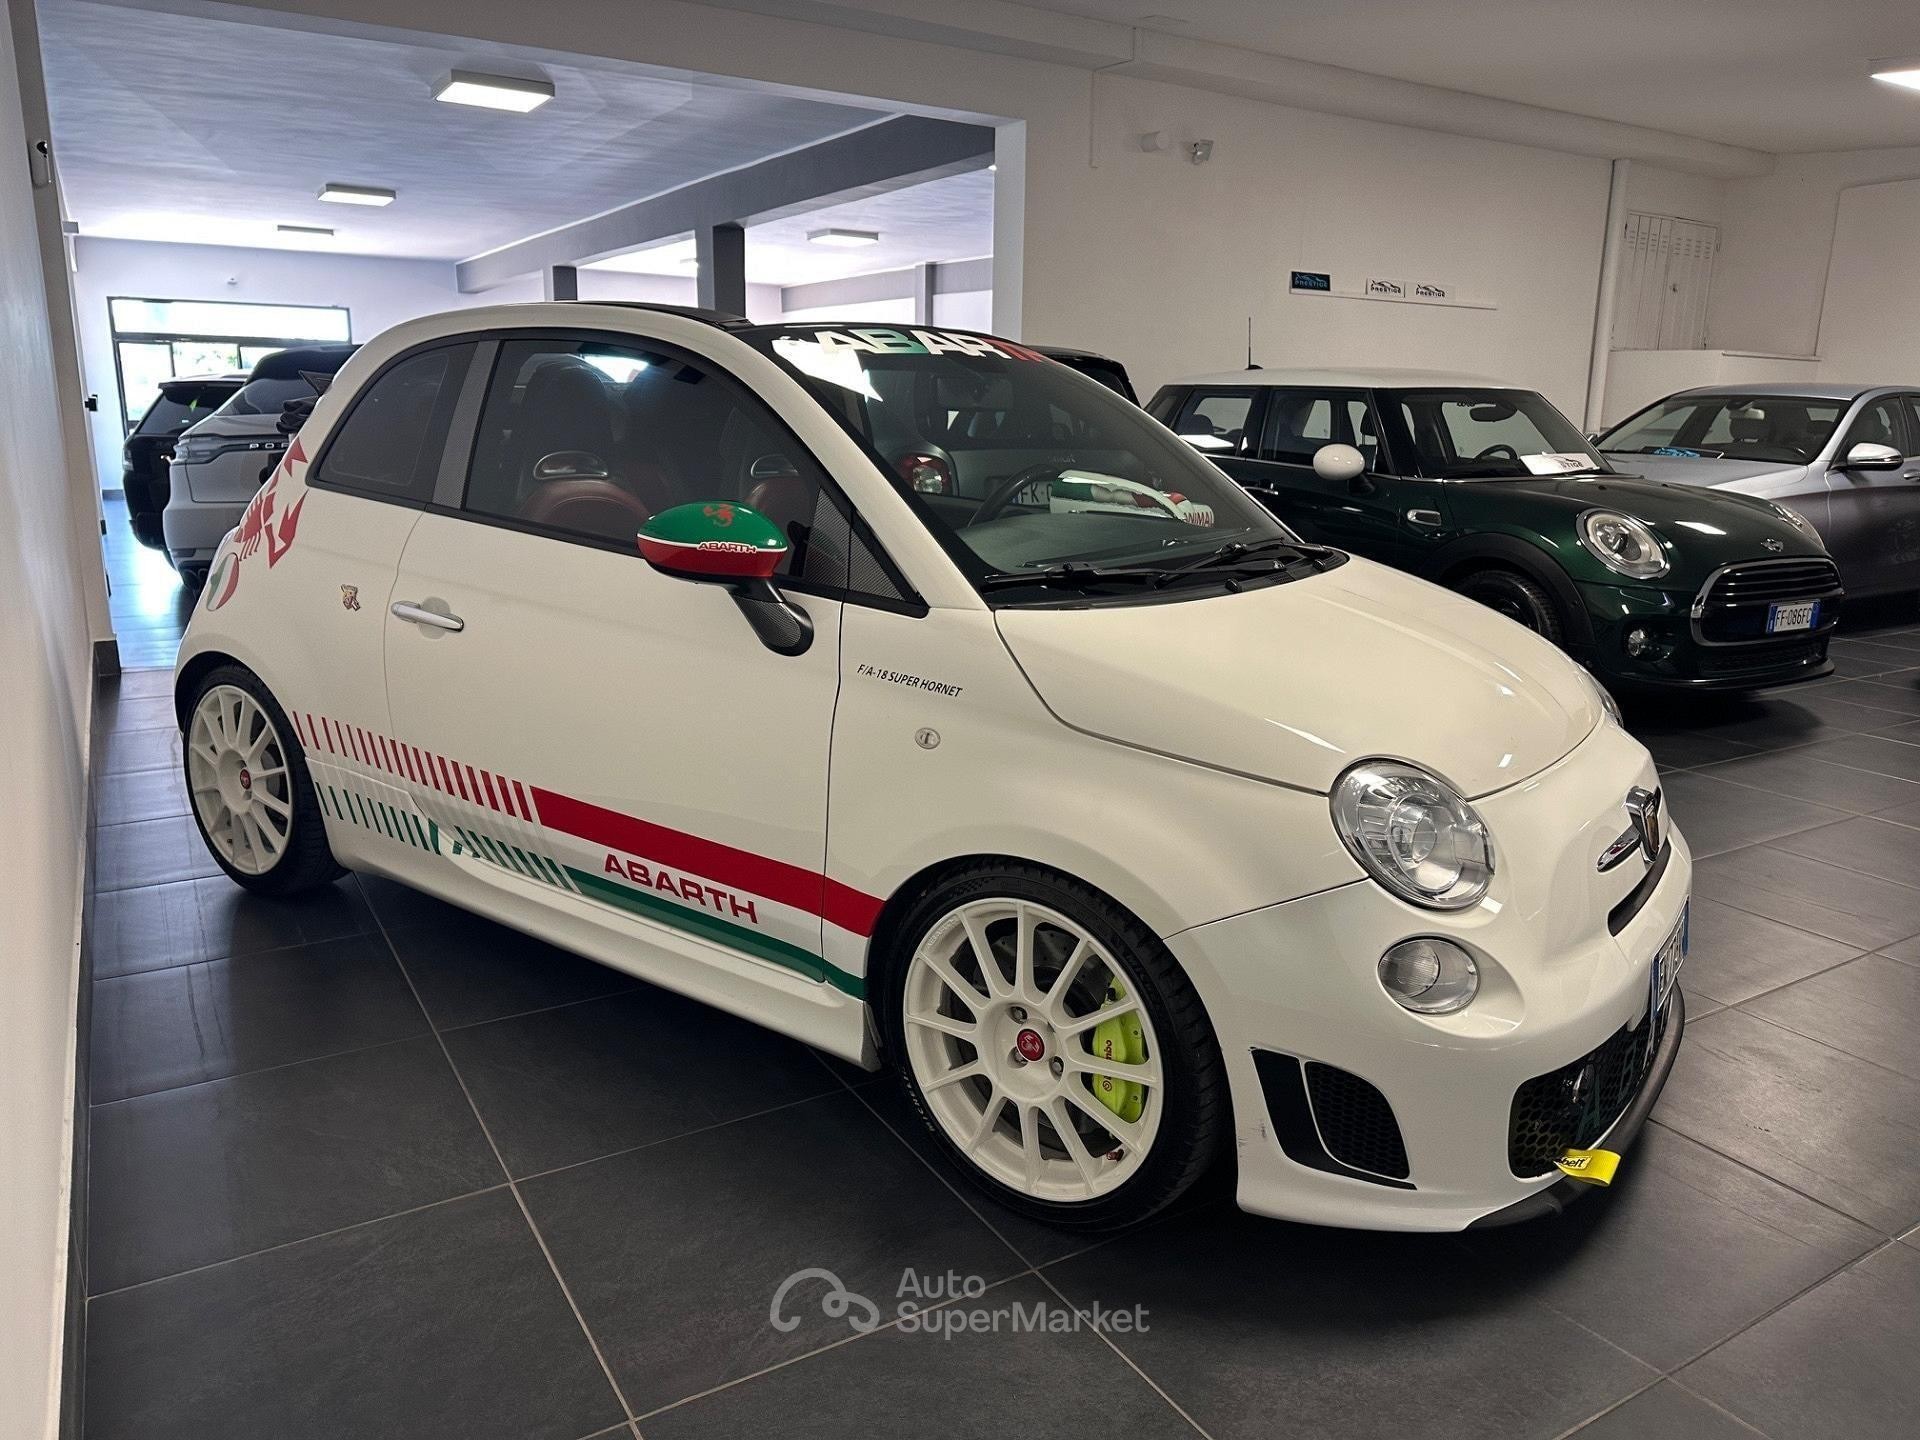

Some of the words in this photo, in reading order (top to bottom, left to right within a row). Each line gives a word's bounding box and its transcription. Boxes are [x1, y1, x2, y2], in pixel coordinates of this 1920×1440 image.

[1371, 286, 1401, 294] PRESTIGE
[1416, 289, 1445, 297] PRESTIGE
[697, 541, 757, 554] ABARTH
[857, 664, 888, 680] F/A-18
[888, 671, 920, 687] SUPER
[919, 679, 963, 697] HORNET
[604, 853, 758, 924] ABARTH
